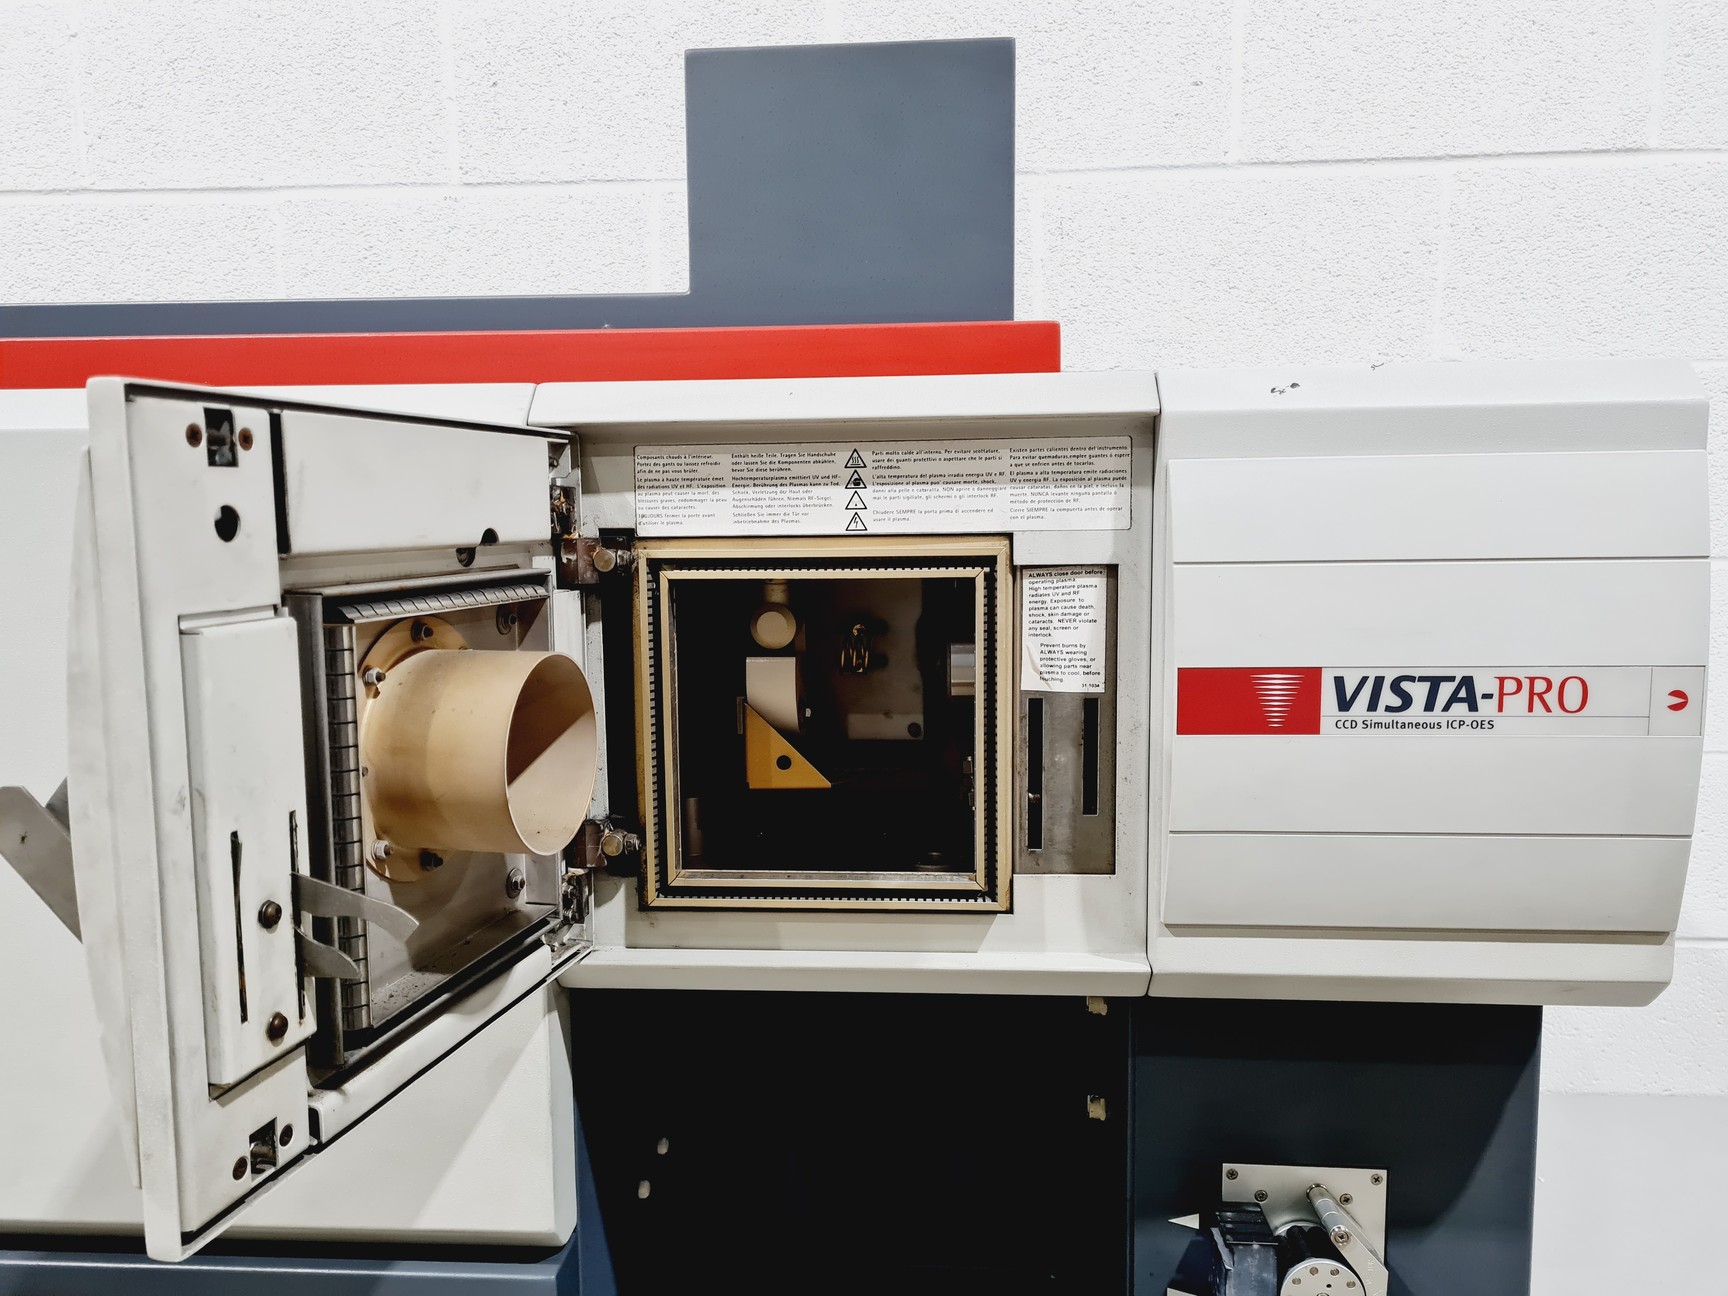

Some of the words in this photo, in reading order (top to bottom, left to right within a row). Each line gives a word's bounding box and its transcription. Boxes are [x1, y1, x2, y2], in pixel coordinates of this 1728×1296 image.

[1028, 578, 1055, 586] operating
[1333, 675, 1589, 714] VISTA-PRO
[1335, 719, 1358, 730] CCD
[1362, 719, 1442, 730] Simultaneous
[1446, 719, 1495, 730] ICP-OES
